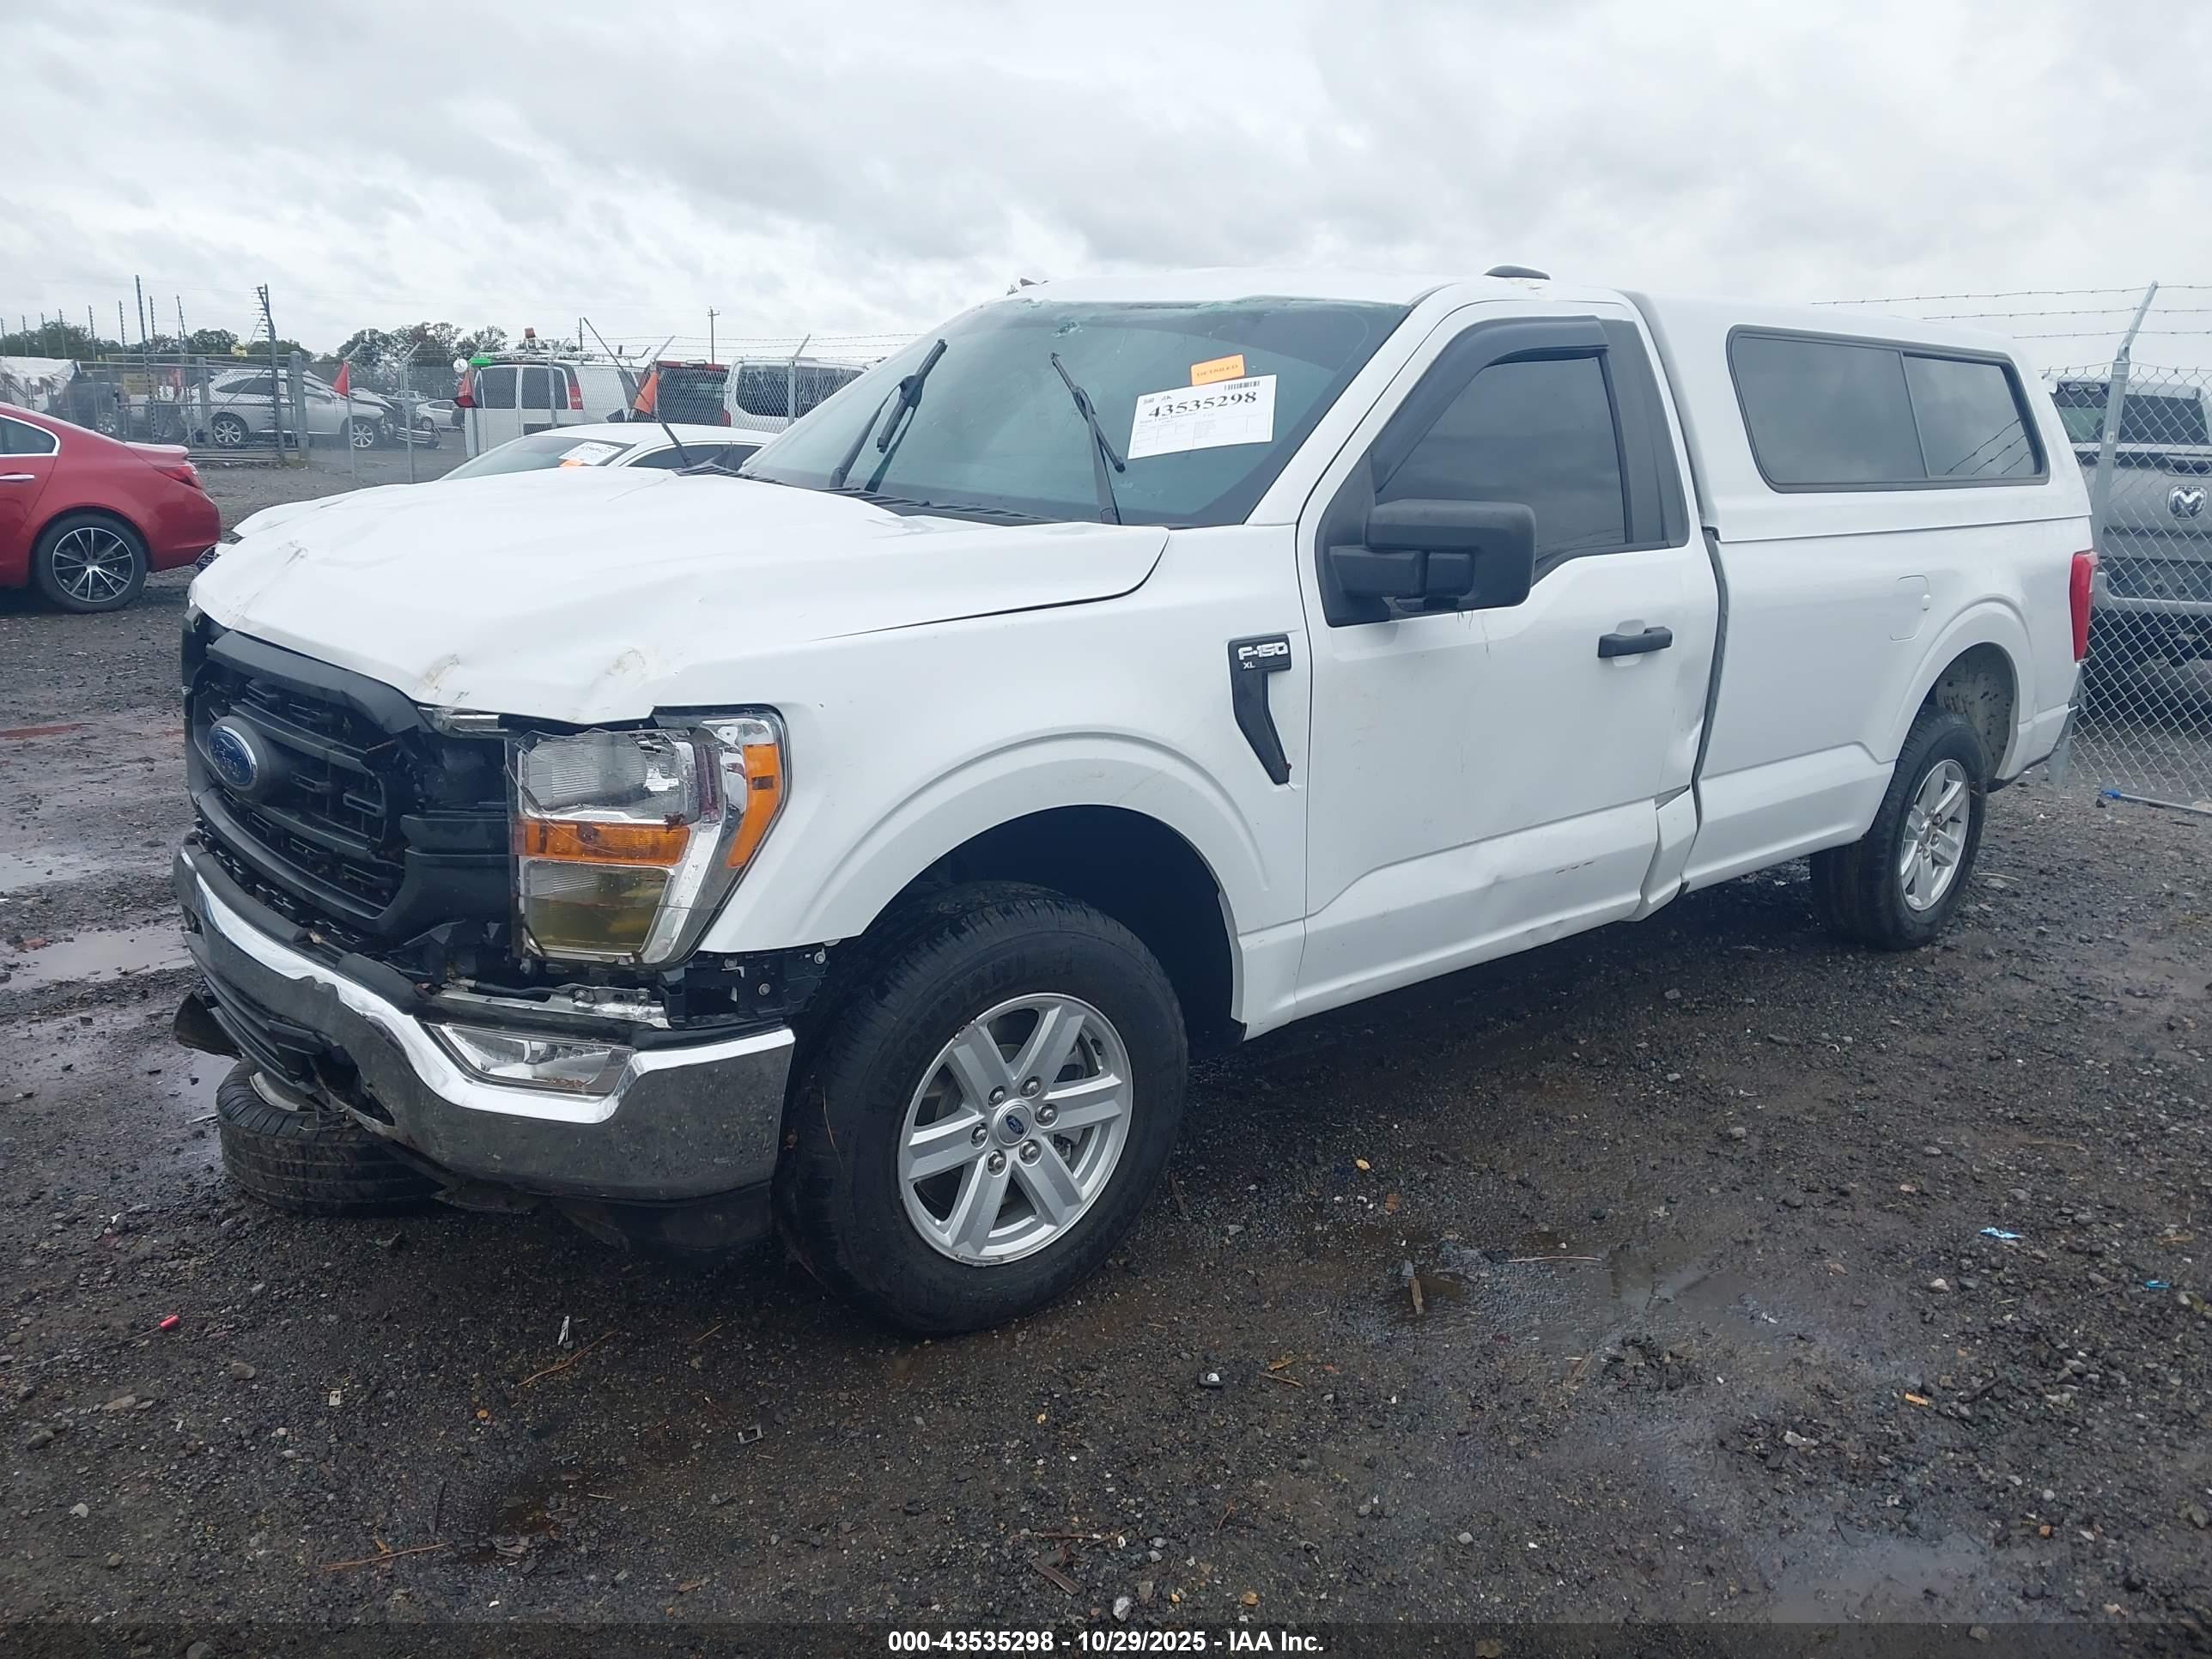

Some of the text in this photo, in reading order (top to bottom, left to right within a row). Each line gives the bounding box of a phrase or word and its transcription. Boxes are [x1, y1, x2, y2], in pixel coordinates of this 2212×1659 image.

[1148, 391, 1257, 418] 43535298
[1237, 641, 1289, 660] F-150
[1243, 661, 1256, 670] XL
